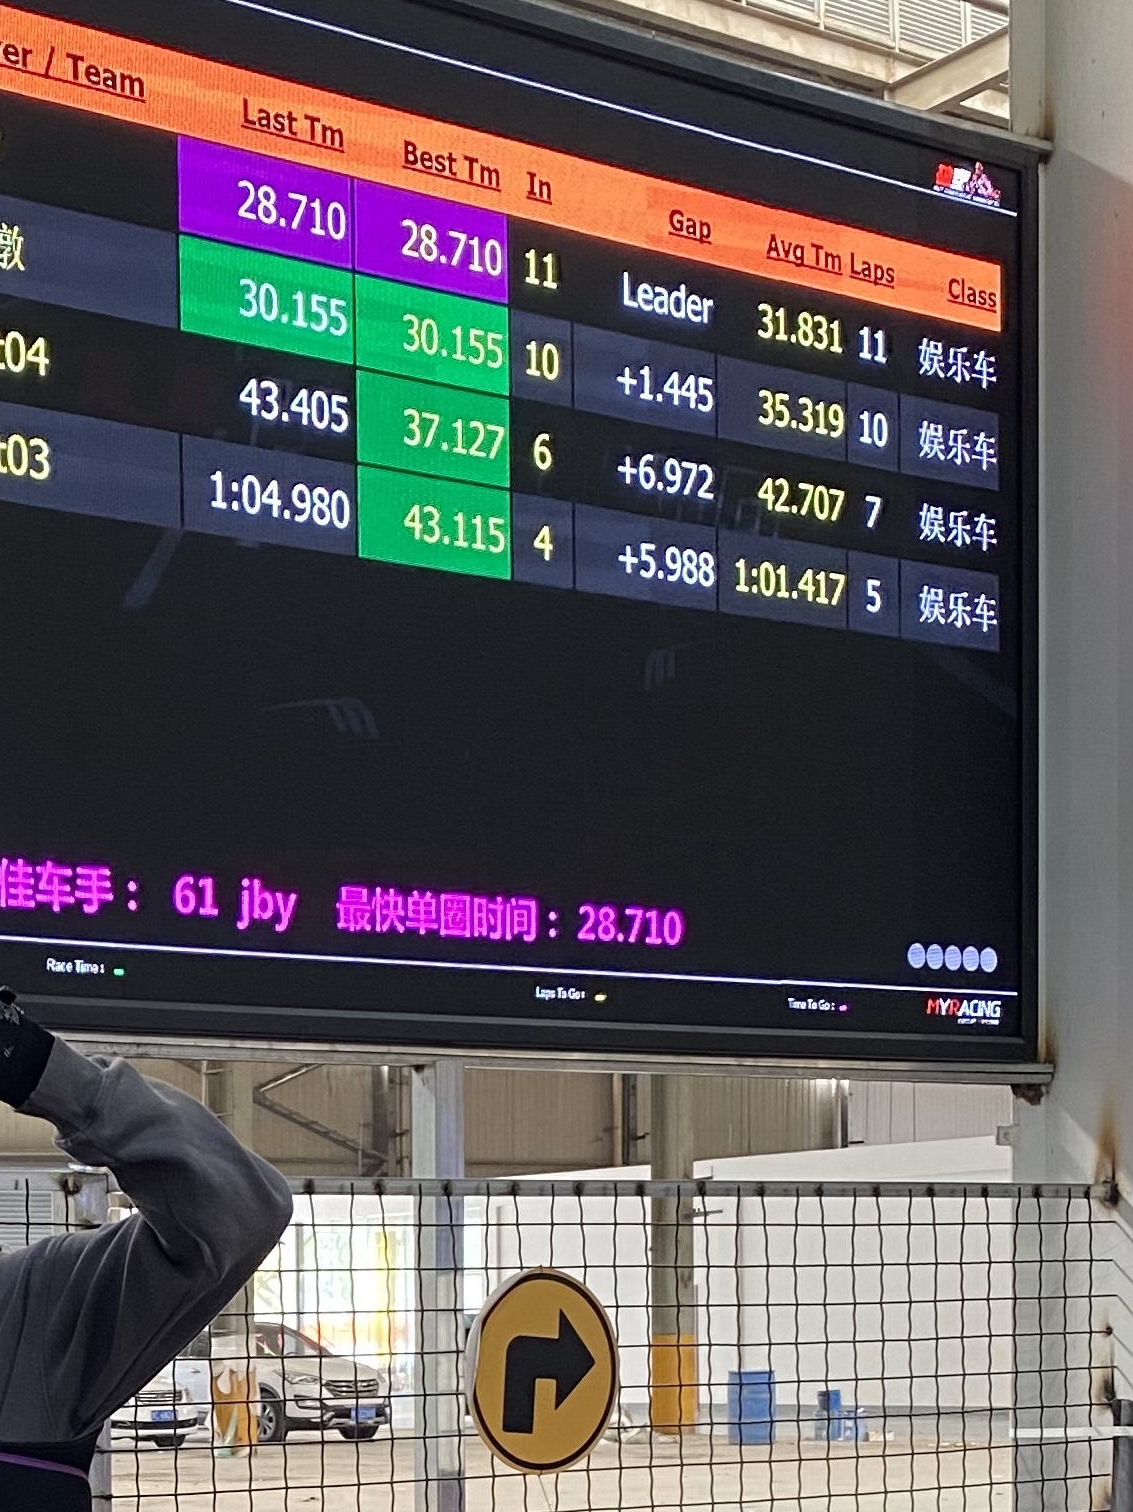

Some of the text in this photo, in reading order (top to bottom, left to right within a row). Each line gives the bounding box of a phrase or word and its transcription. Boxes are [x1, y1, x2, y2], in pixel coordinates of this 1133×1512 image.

[66, 52, 146, 98] Team
[242, 98, 298, 137] Last
[304, 114, 345, 149] Tm
[403, 140, 457, 176] Best
[464, 156, 500, 188] Tm
[527, 171, 553, 201] In
[668, 210, 712, 243] Gap
[767, 234, 805, 266] Avg
[812, 243, 843, 273] Tm
[849, 252, 895, 286] Laps
[948, 278, 997, 309] Class
[237, 180, 346, 241] 28.710
[400, 219, 503, 276] 28.710
[524, 249, 558, 290] 11
[623, 271, 713, 325] Leader
[757, 304, 844, 354] 31.831
[859, 327, 888, 364] 11
[918, 337, 997, 390] 娱乐车
[239, 278, 348, 337] 30.155
[402, 313, 504, 369] 30.155
[525, 341, 560, 381] 10
[616, 365, 714, 413] +1.445
[758, 390, 845, 438] 35.319
[859, 411, 889, 447] 10
[918, 418, 998, 471] 娱乐车
[239, 378, 349, 433] 43.405
[403, 408, 505, 460] 37.127
[533, 433, 553, 471] 6
[617, 453, 715, 501] +6.972
[758, 477, 846, 522] 42.707
[864, 495, 883, 529] 7
[918, 502, 998, 552] 娱乐车
[209, 471, 351, 530] 1:04.980
[404, 504, 506, 554] 43.115
[533, 525, 554, 562] 4
[618, 543, 716, 588] +5.988
[734, 559, 847, 606] 1:01.417
[866, 579, 882, 614] 5
[919, 585, 998, 634] 娱乐车
[174, 875, 220, 917] 61
[236, 877, 297, 933] jby
[577, 904, 684, 948] 28.710
[926, 998, 1002, 1018] MYRACING
